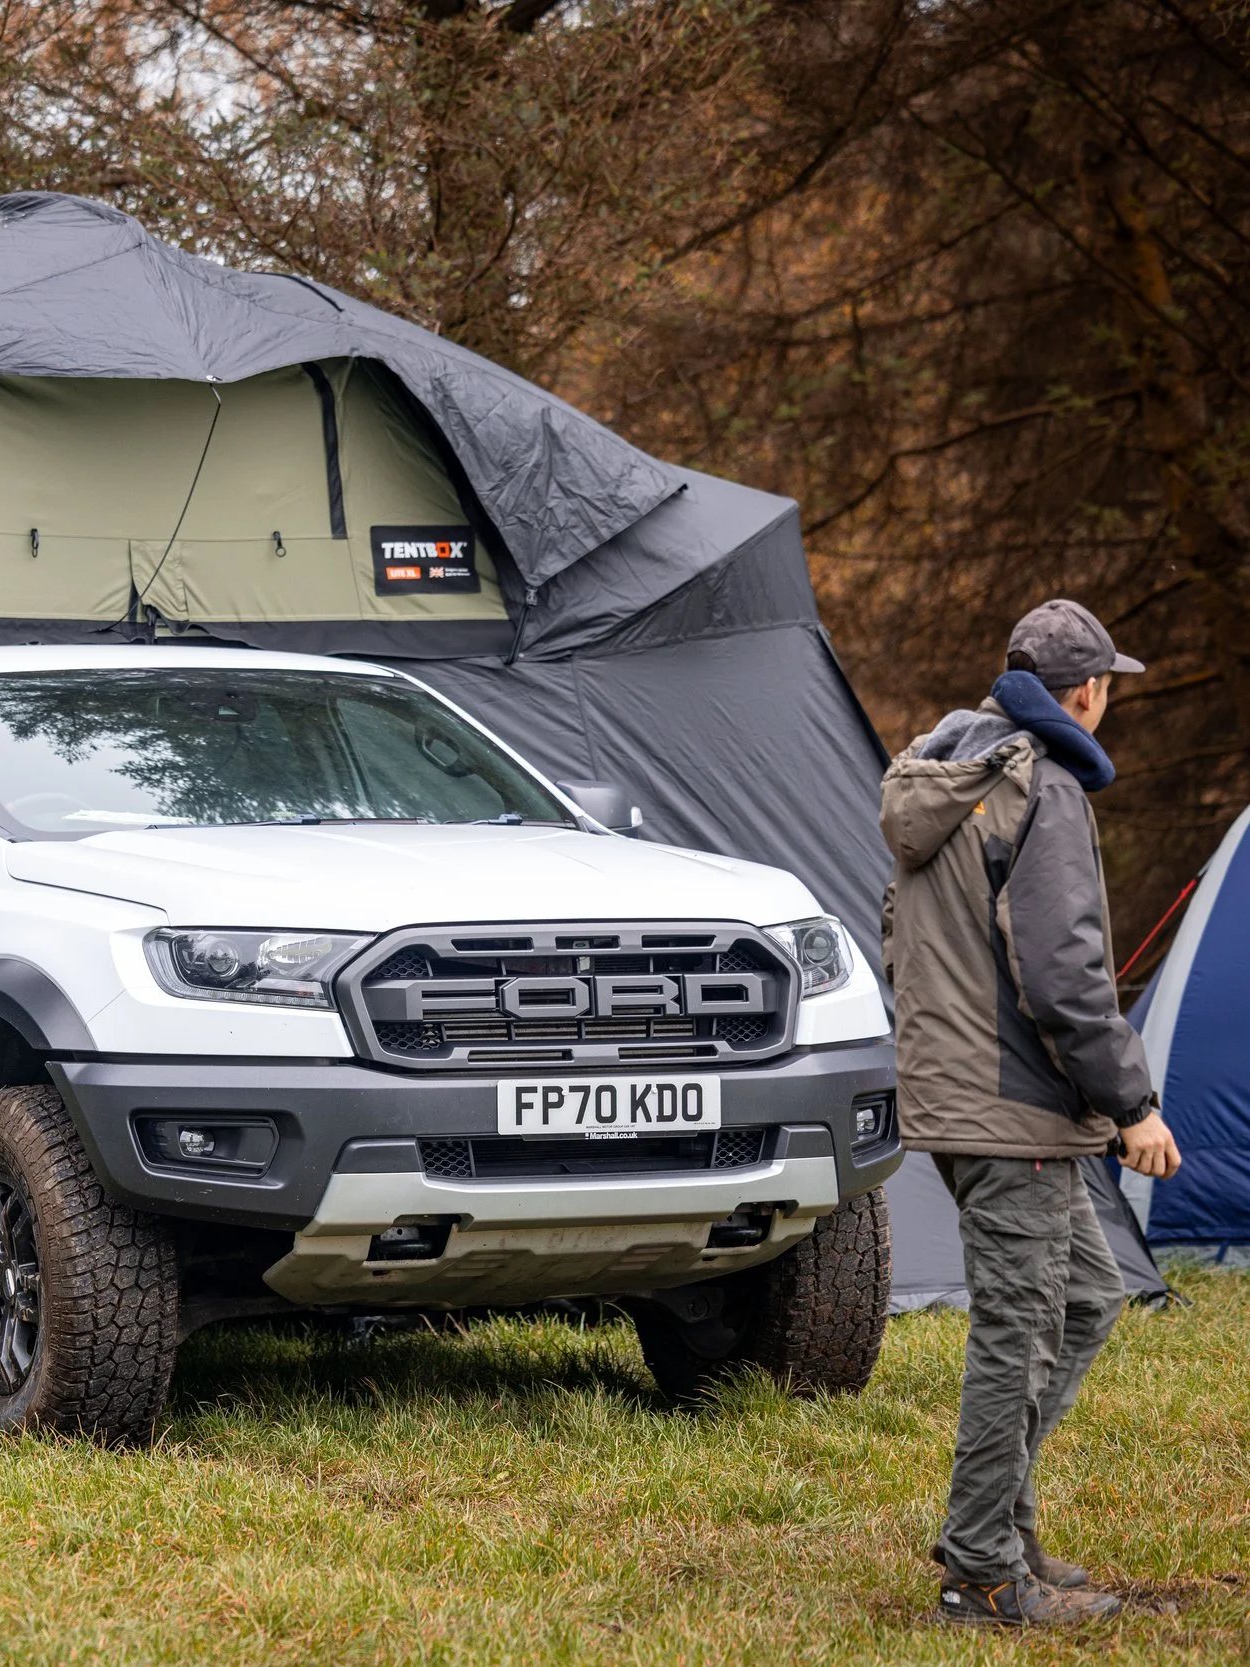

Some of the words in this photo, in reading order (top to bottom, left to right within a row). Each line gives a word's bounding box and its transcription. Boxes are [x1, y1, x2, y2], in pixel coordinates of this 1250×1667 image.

[406, 973, 764, 1021] FORD
[515, 1084, 617, 1126] FP70
[630, 1082, 703, 1123] KDO
[589, 1131, 638, 1140] Marshall.co.uk
